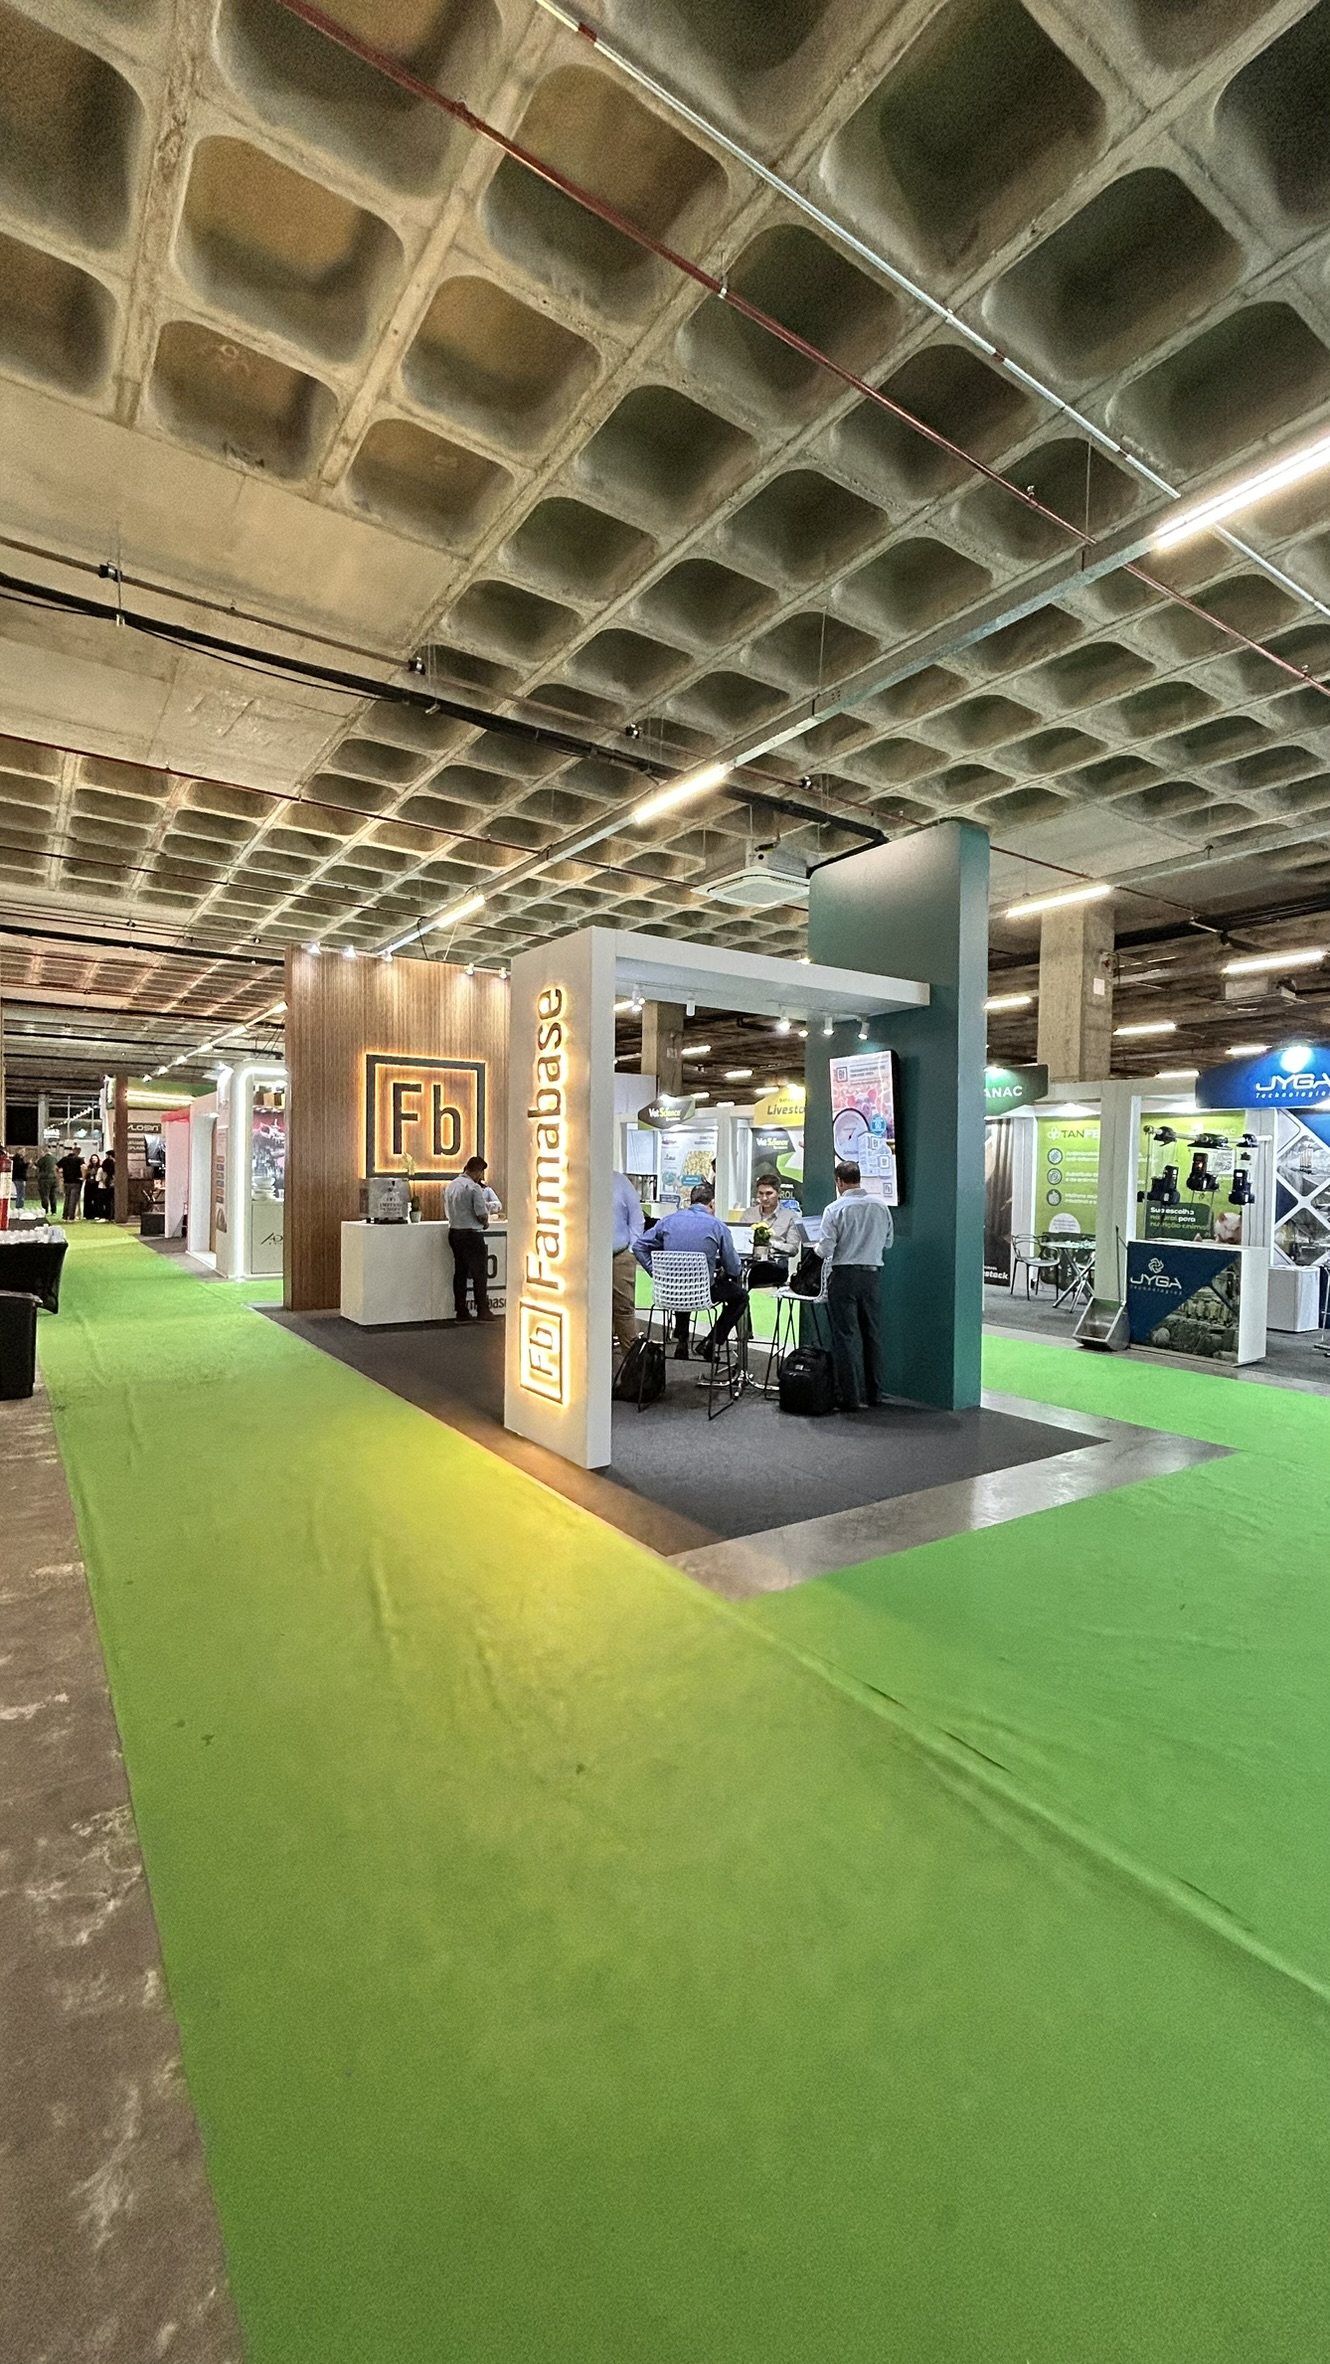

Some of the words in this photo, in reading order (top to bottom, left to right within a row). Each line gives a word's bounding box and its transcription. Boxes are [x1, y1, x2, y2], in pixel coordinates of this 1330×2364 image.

[1256, 1072, 1330, 1091] JYGA
[1256, 1090, 1330, 1099] Technologie
[392, 1082, 461, 1156] Fb
[526, 988, 563, 1291] Farmabase
[1129, 1272, 1183, 1290] JYGA
[528, 1326, 554, 1378] Fb
